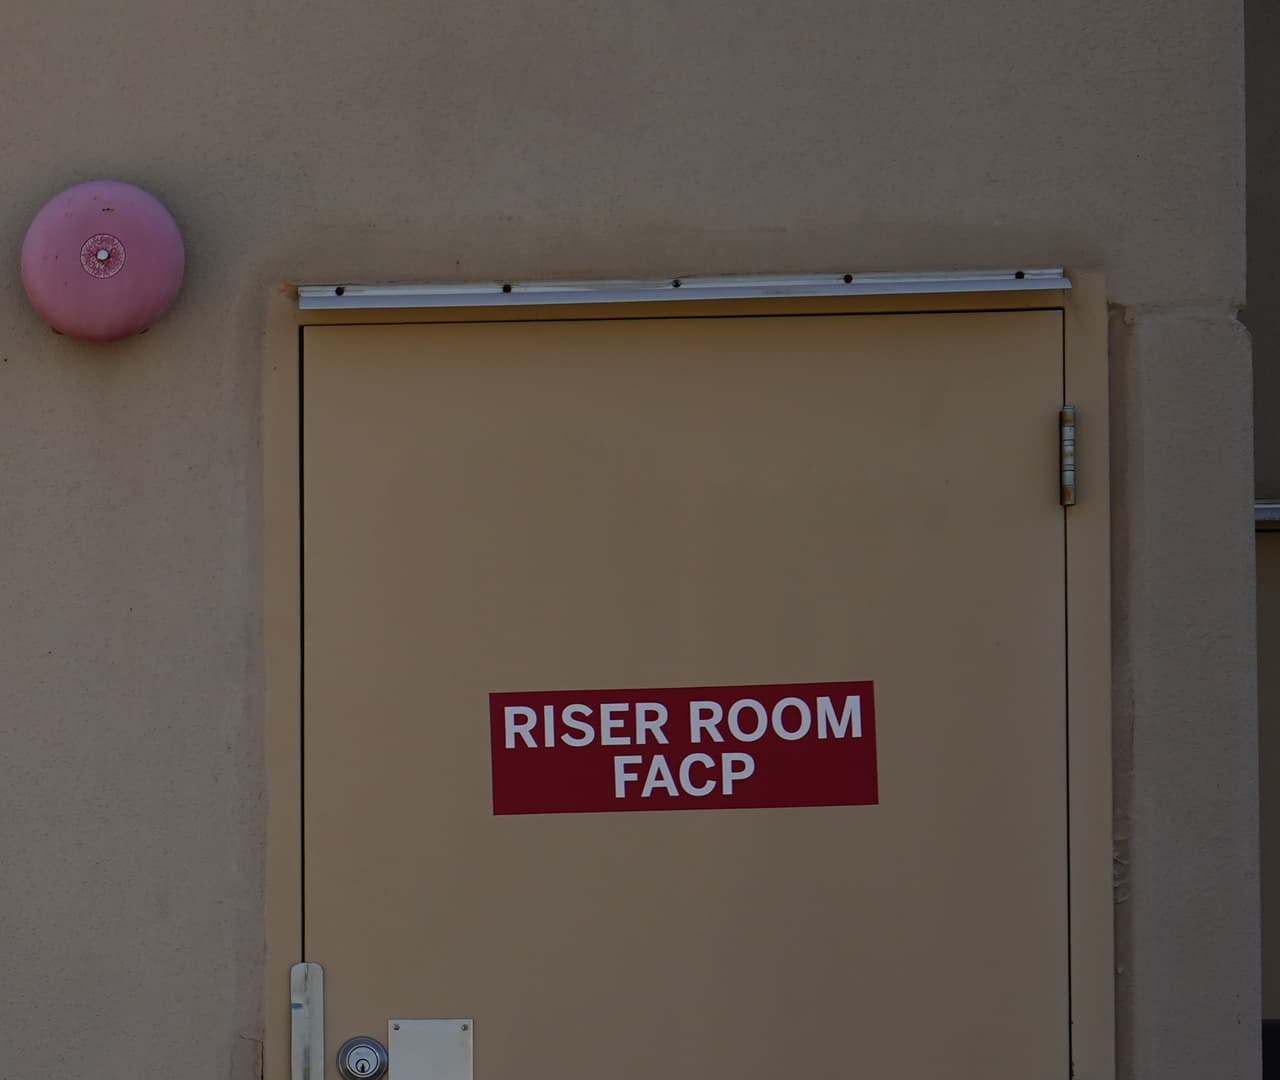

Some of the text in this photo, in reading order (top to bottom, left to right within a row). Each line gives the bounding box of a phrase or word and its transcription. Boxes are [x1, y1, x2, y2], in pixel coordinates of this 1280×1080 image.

[504, 695, 863, 749] RISER ROOM
[613, 752, 756, 799] FACP
